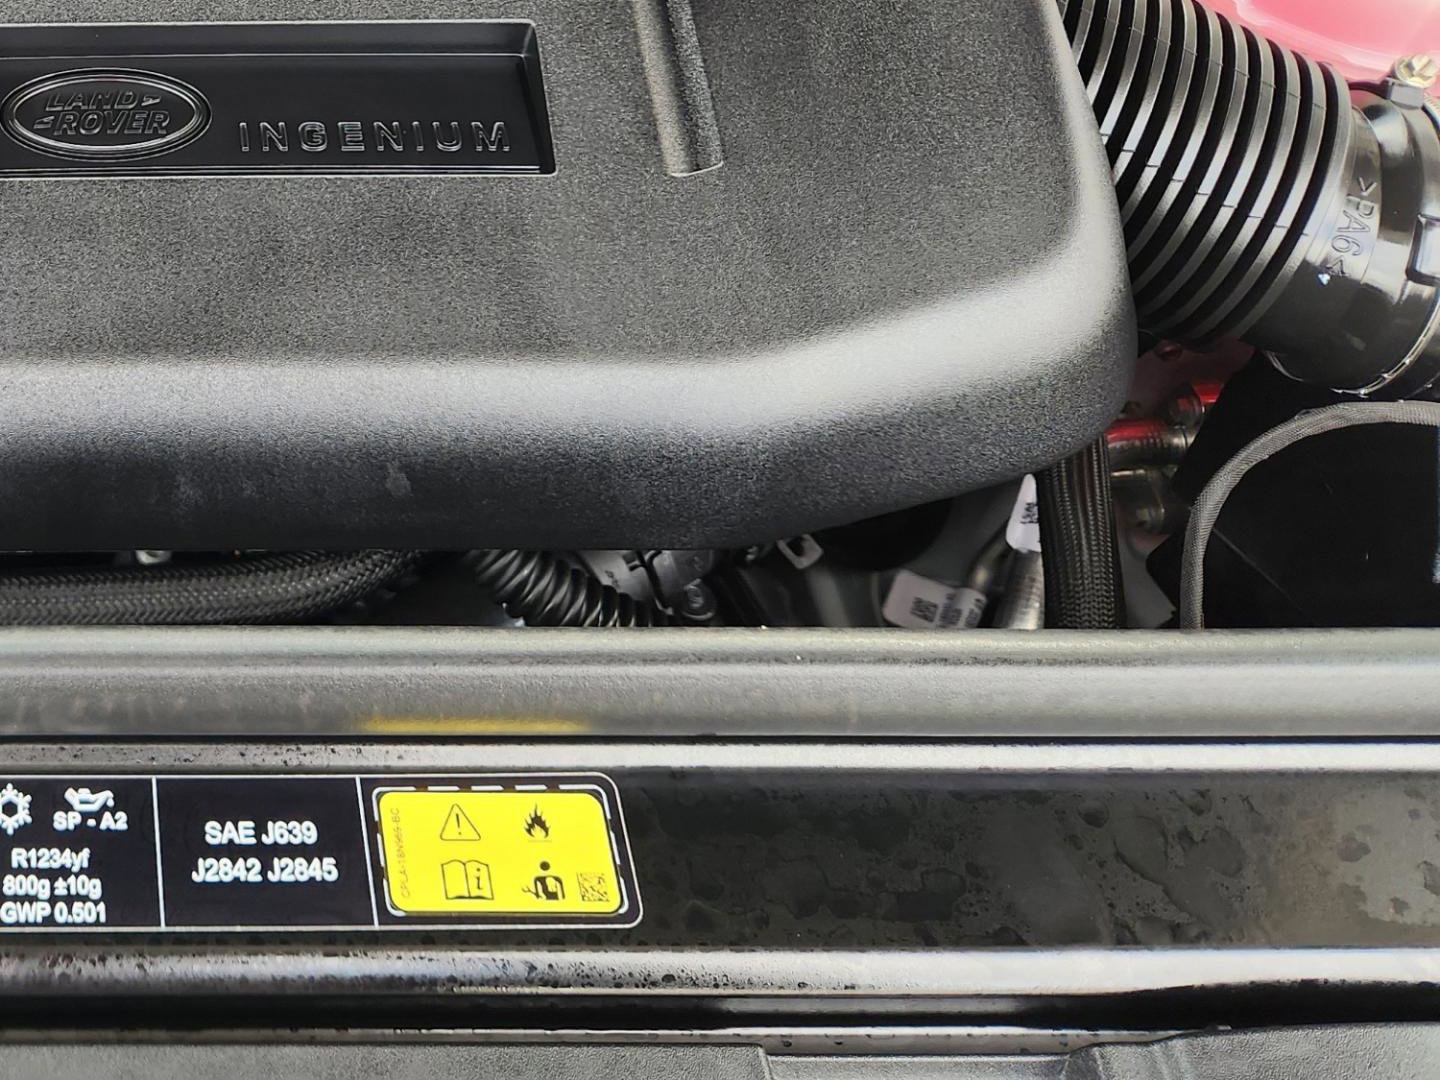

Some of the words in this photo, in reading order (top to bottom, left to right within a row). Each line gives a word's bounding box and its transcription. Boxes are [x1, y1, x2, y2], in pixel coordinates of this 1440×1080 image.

[45, 90, 142, 112] LAND
[54, 110, 169, 136] ROVER
[239, 121, 511, 152] INGENIUM
[53, 811, 82, 831] SP
[99, 811, 128, 831] A2
[204, 820, 257, 845] SAE
[261, 820, 318, 845] J639
[10, 848, 91, 872] R1234yf
[191, 857, 263, 882] J2842
[267, 857, 339, 882] J2845
[2, 874, 51, 900] 800g
[54, 874, 103, 900] ±10g
[0, 901, 52, 923] GWP
[53, 901, 107, 923] 0.501
